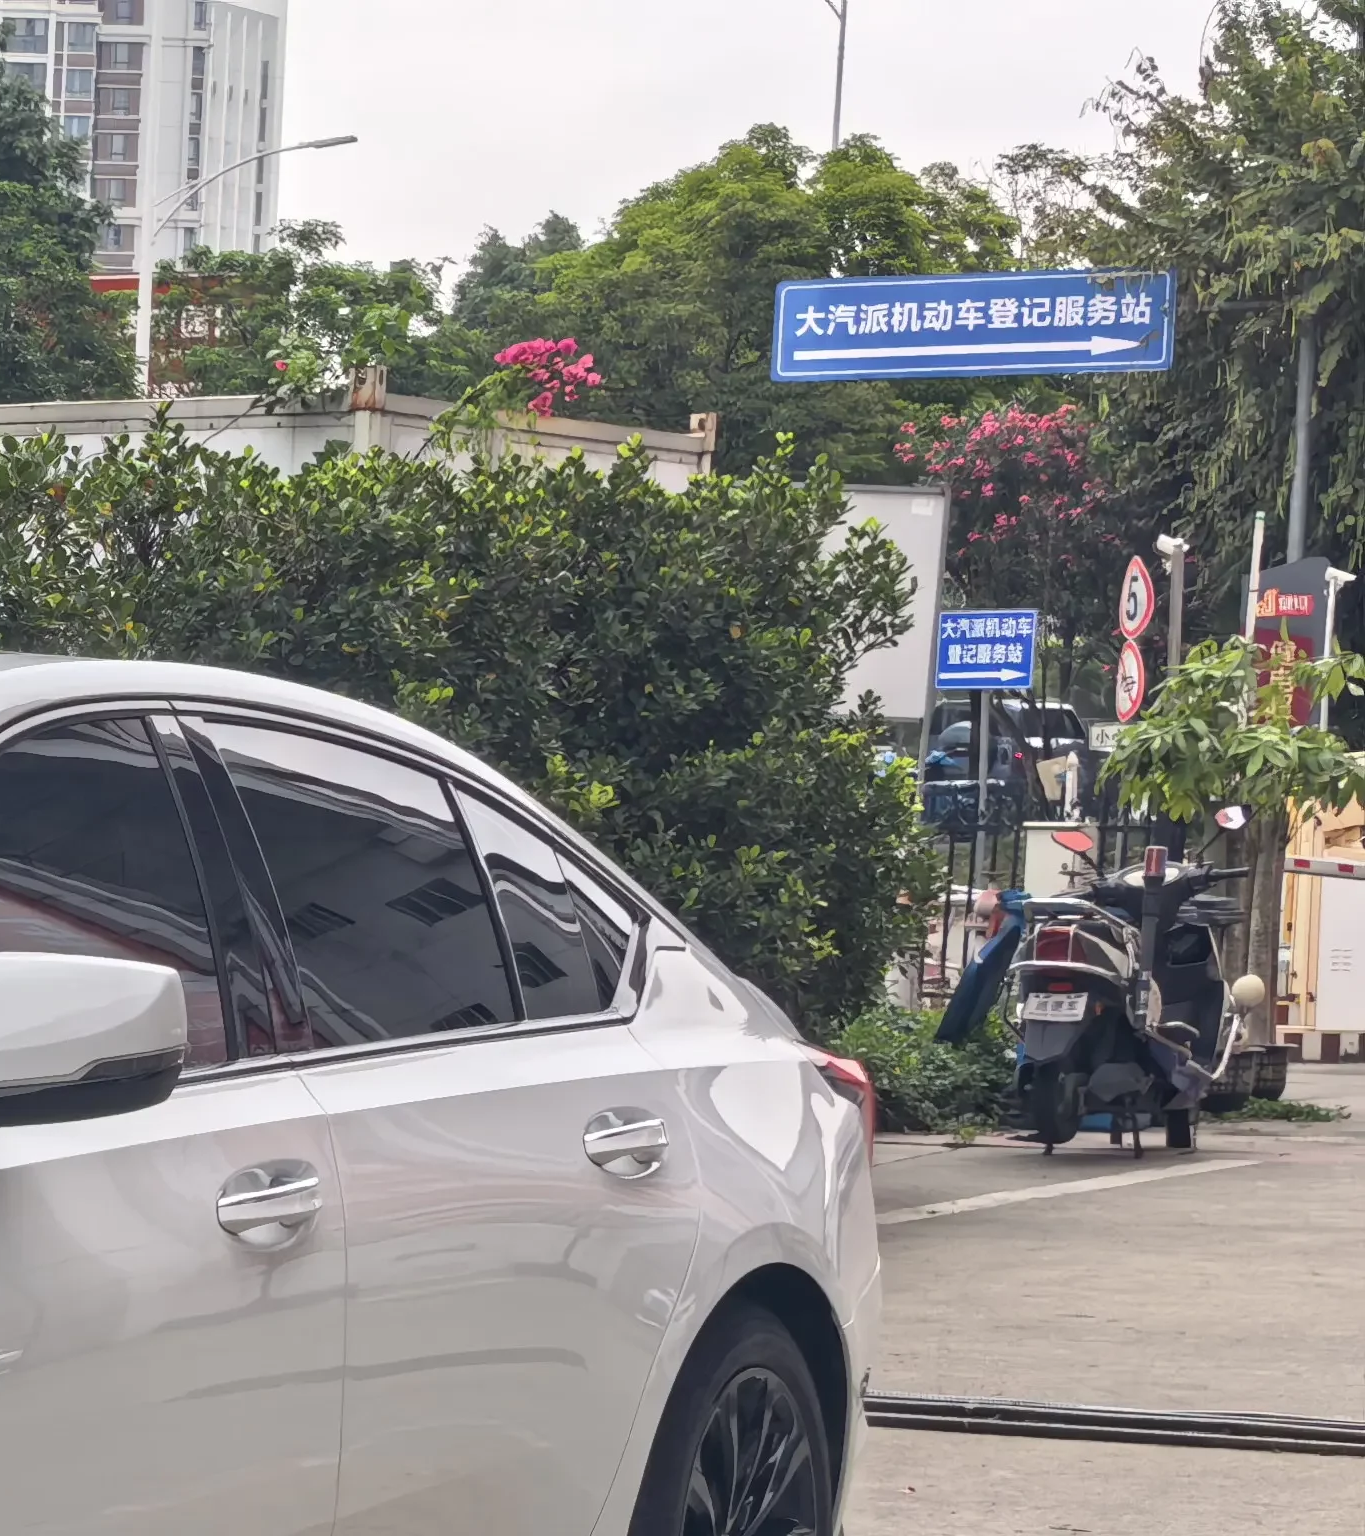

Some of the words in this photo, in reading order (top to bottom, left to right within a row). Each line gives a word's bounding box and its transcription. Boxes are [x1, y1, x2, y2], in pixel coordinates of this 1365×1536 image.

[794, 292, 1154, 338] 大汽派机动车登记服务站
[1125, 574, 1139, 621] 5
[946, 642, 1023, 665] 登记服务站
